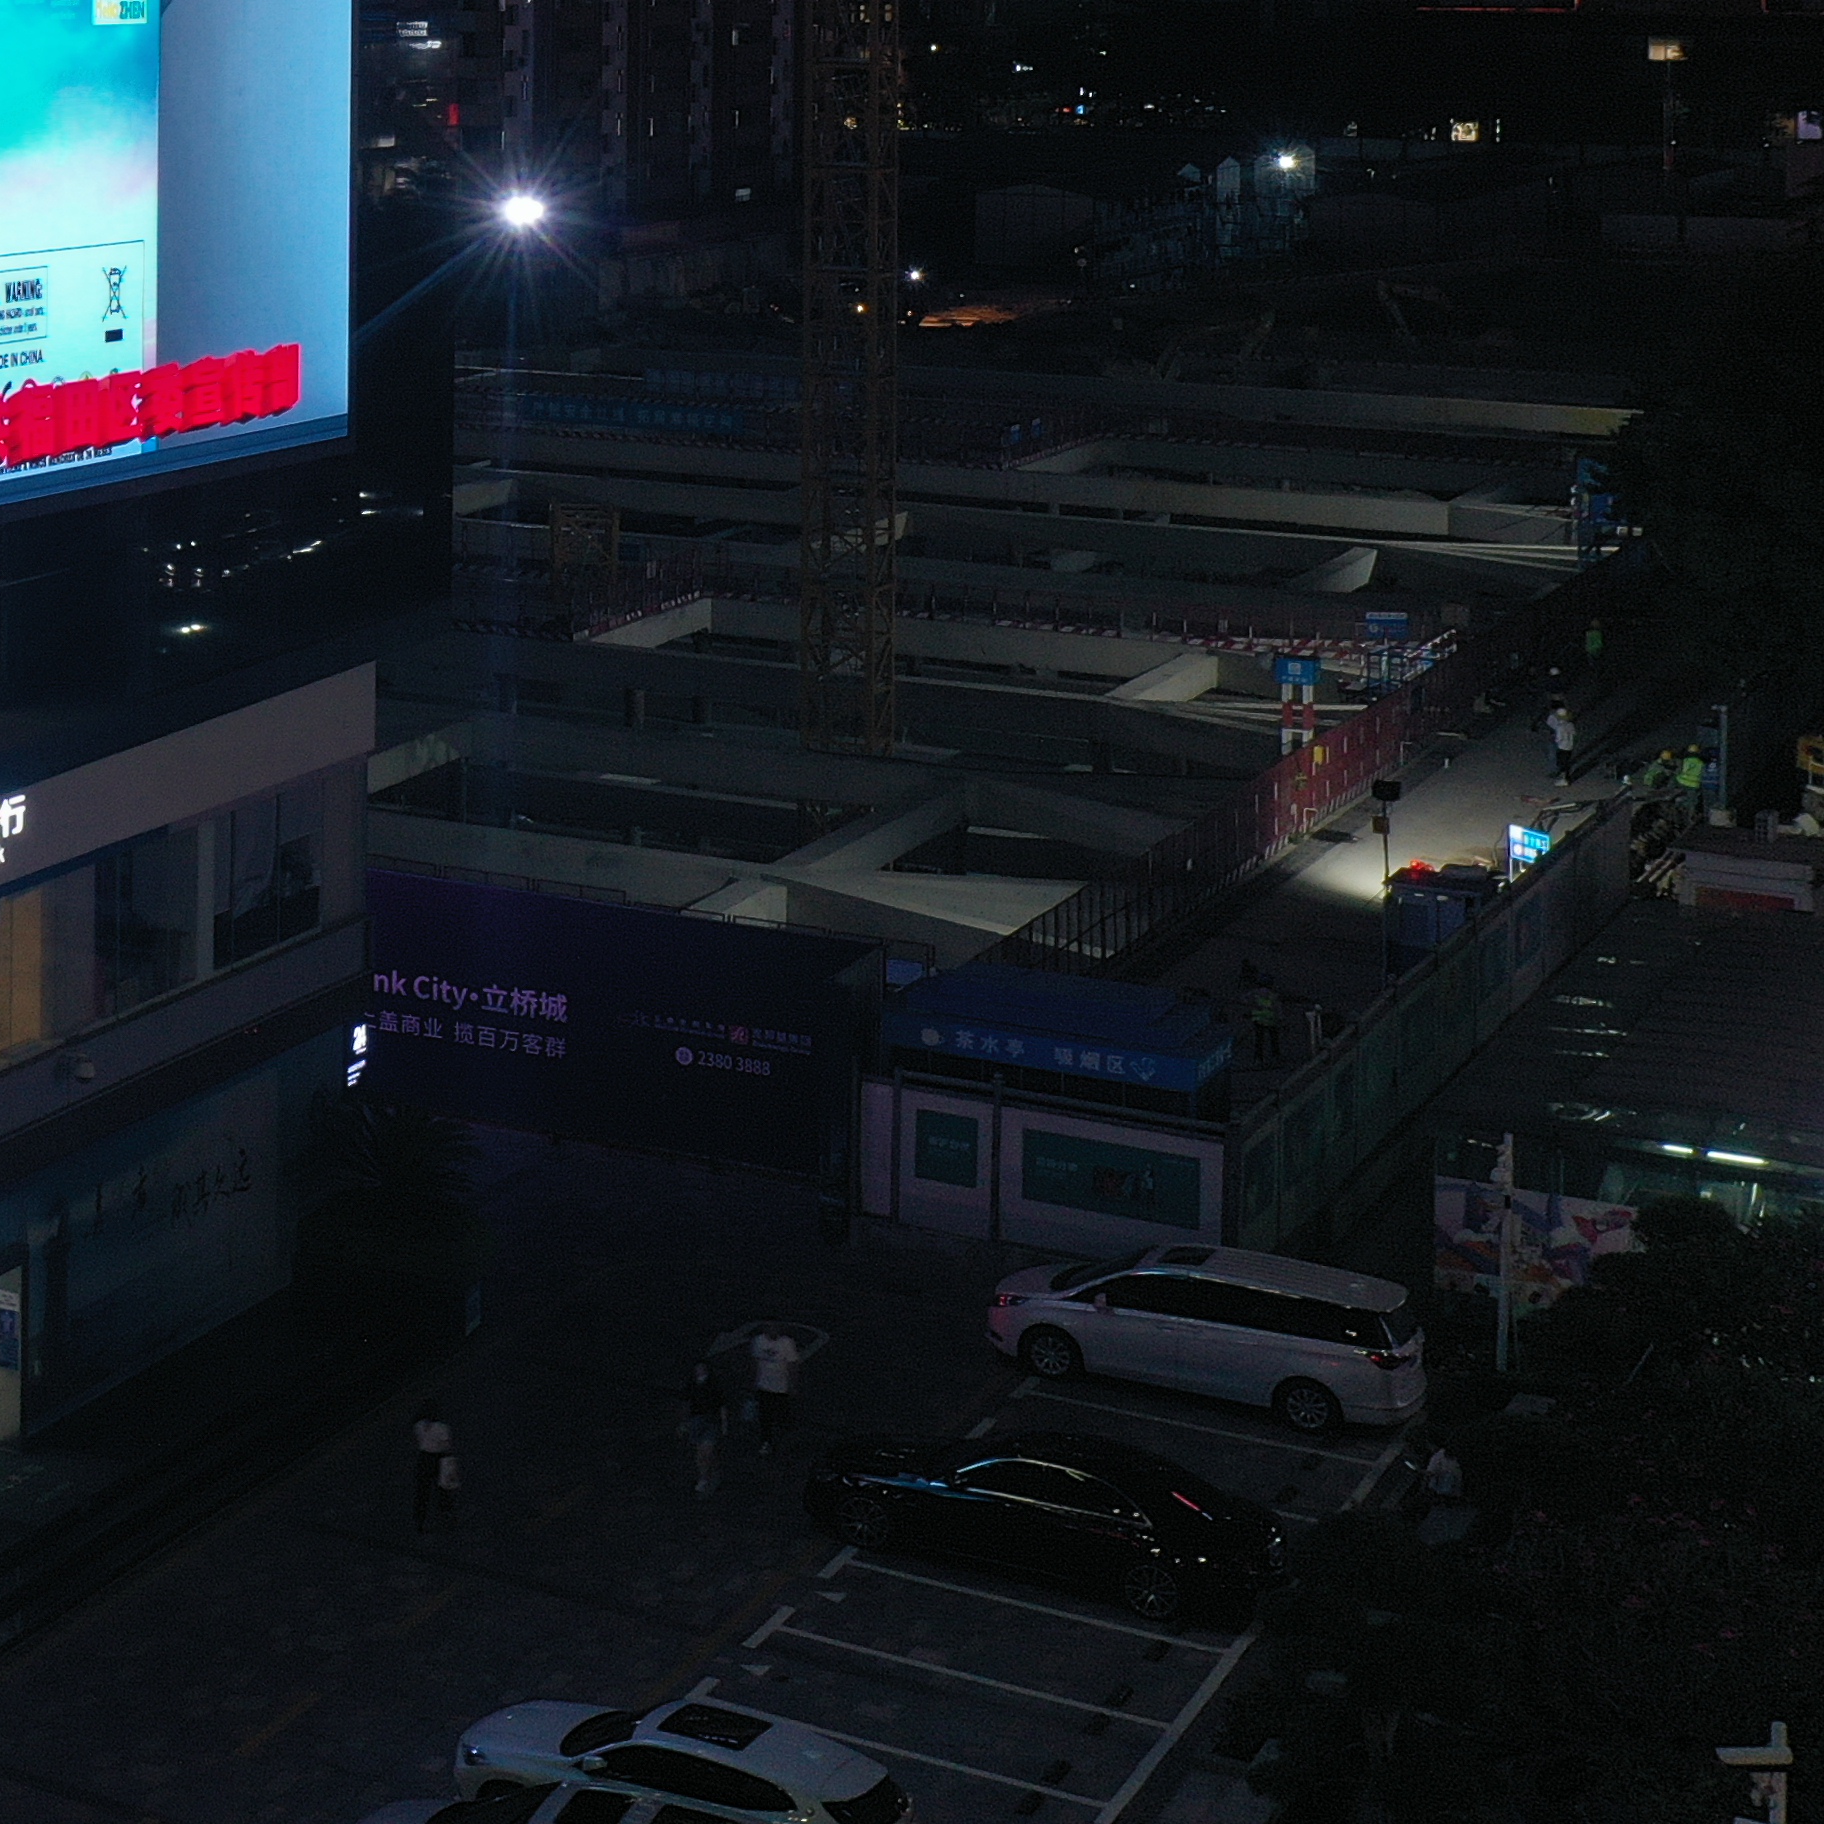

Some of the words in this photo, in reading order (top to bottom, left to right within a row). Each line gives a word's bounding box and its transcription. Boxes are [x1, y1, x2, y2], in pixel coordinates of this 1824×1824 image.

[10, 352, 19, 367] IN
[20, 349, 43, 365] CHINA
[454, 1021, 568, 1060] 揽百万客群
[697, 1049, 733, 1071] 2380
[735, 1055, 772, 1077] 3888
